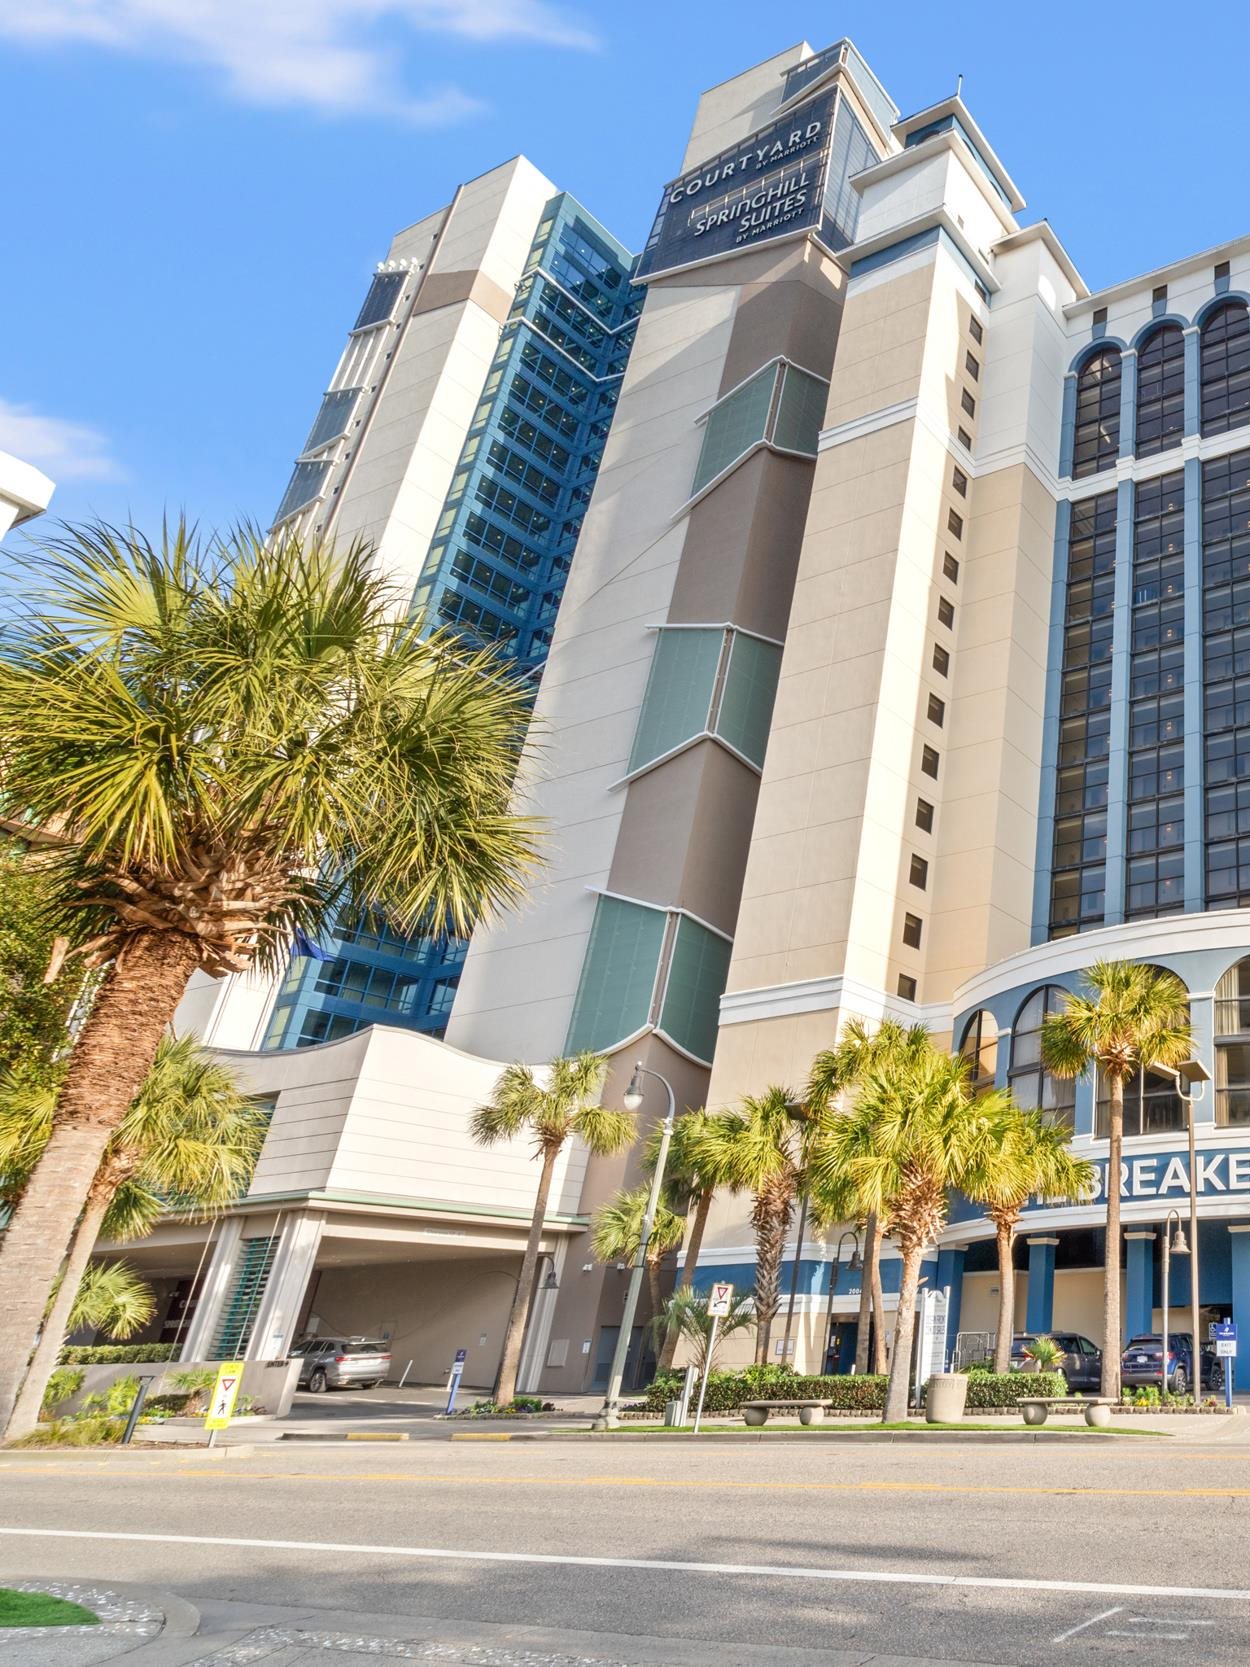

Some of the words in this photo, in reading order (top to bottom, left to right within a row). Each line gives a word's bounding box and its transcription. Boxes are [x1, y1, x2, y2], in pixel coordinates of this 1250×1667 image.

[671, 122, 821, 203] COURTYARD
[756, 159, 768, 169] BY
[770, 136, 819, 162] MARRIOTT
[694, 172, 809, 235] SPRINGHILL
[736, 231, 749, 243] BY
[752, 207, 804, 236] MARRIOTT
[739, 189, 807, 232] SUITES
